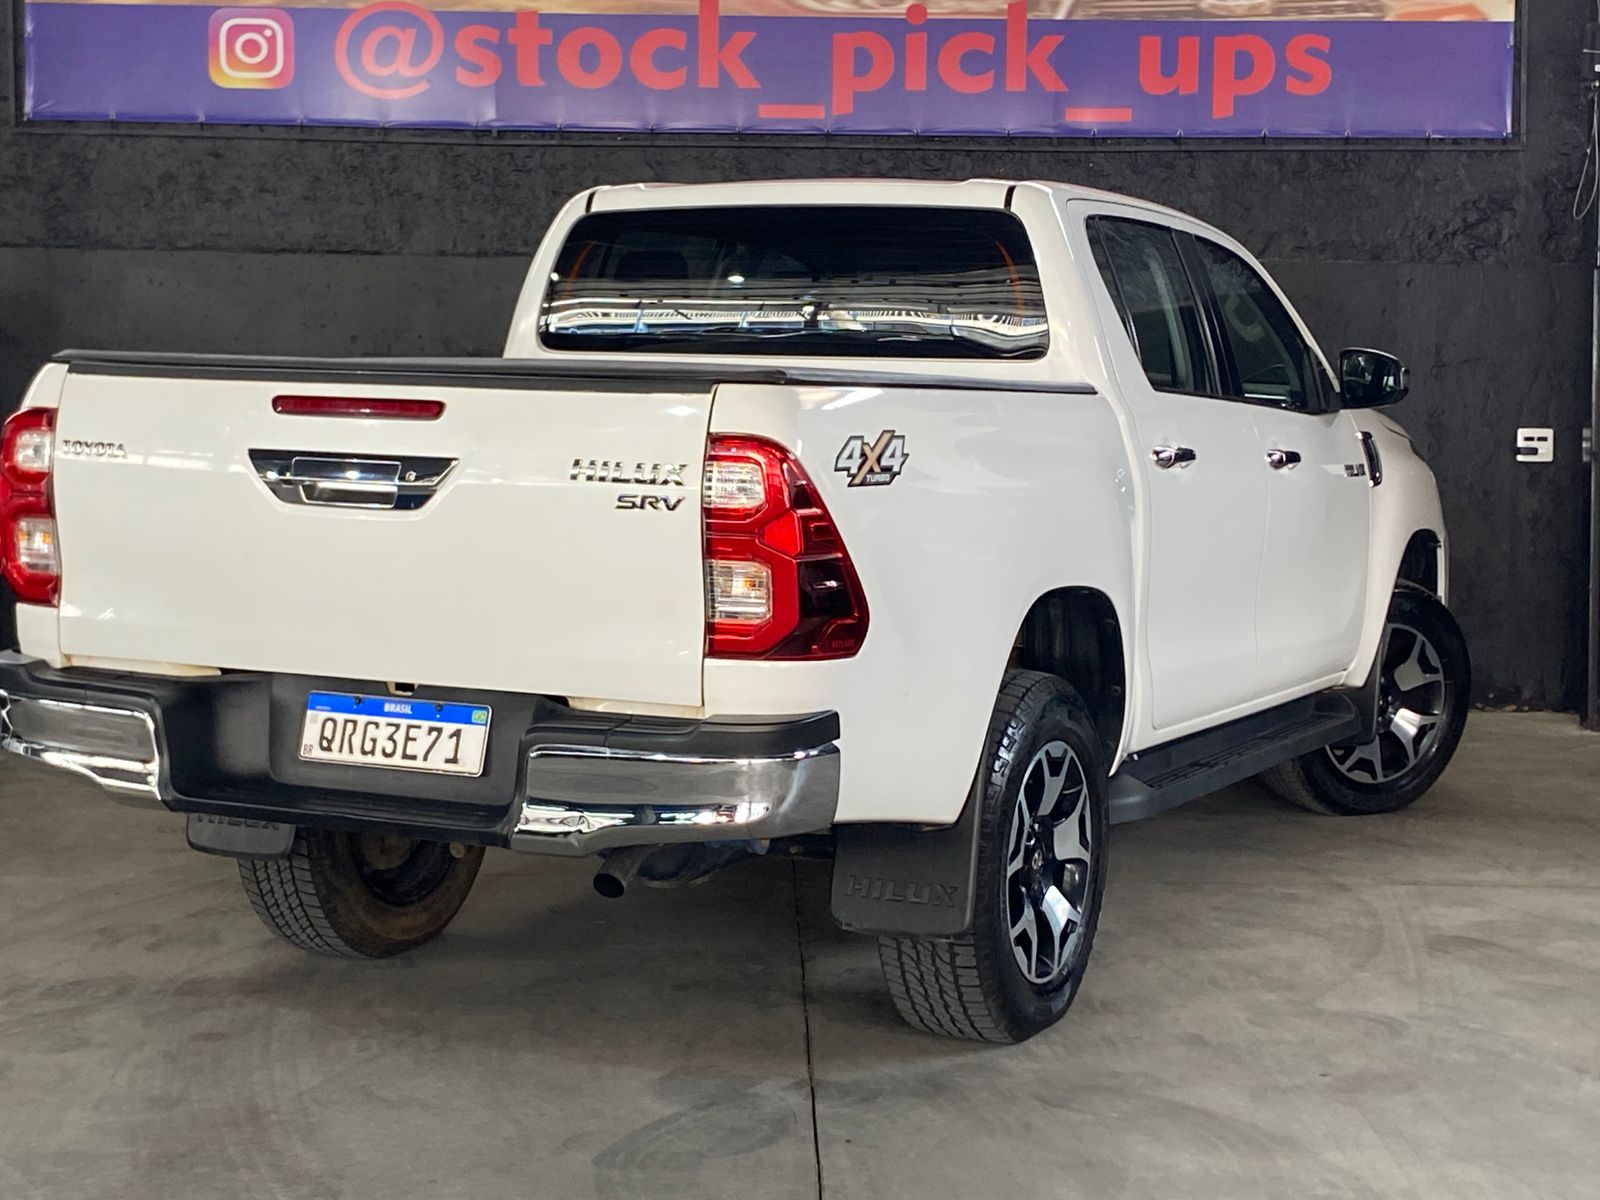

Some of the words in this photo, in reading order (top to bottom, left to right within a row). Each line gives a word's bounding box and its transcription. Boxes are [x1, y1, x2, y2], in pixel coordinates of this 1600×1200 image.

[335, 0, 1334, 122] @stock_pick_ups
[62, 439, 128, 459] TOYOTA
[570, 458, 688, 486] HILUX
[615, 493, 686, 511] SRV
[383, 702, 413, 714] BRASIL
[303, 743, 314, 756] BR
[318, 717, 463, 764] QRG3E71
[845, 874, 959, 908] HILUX
